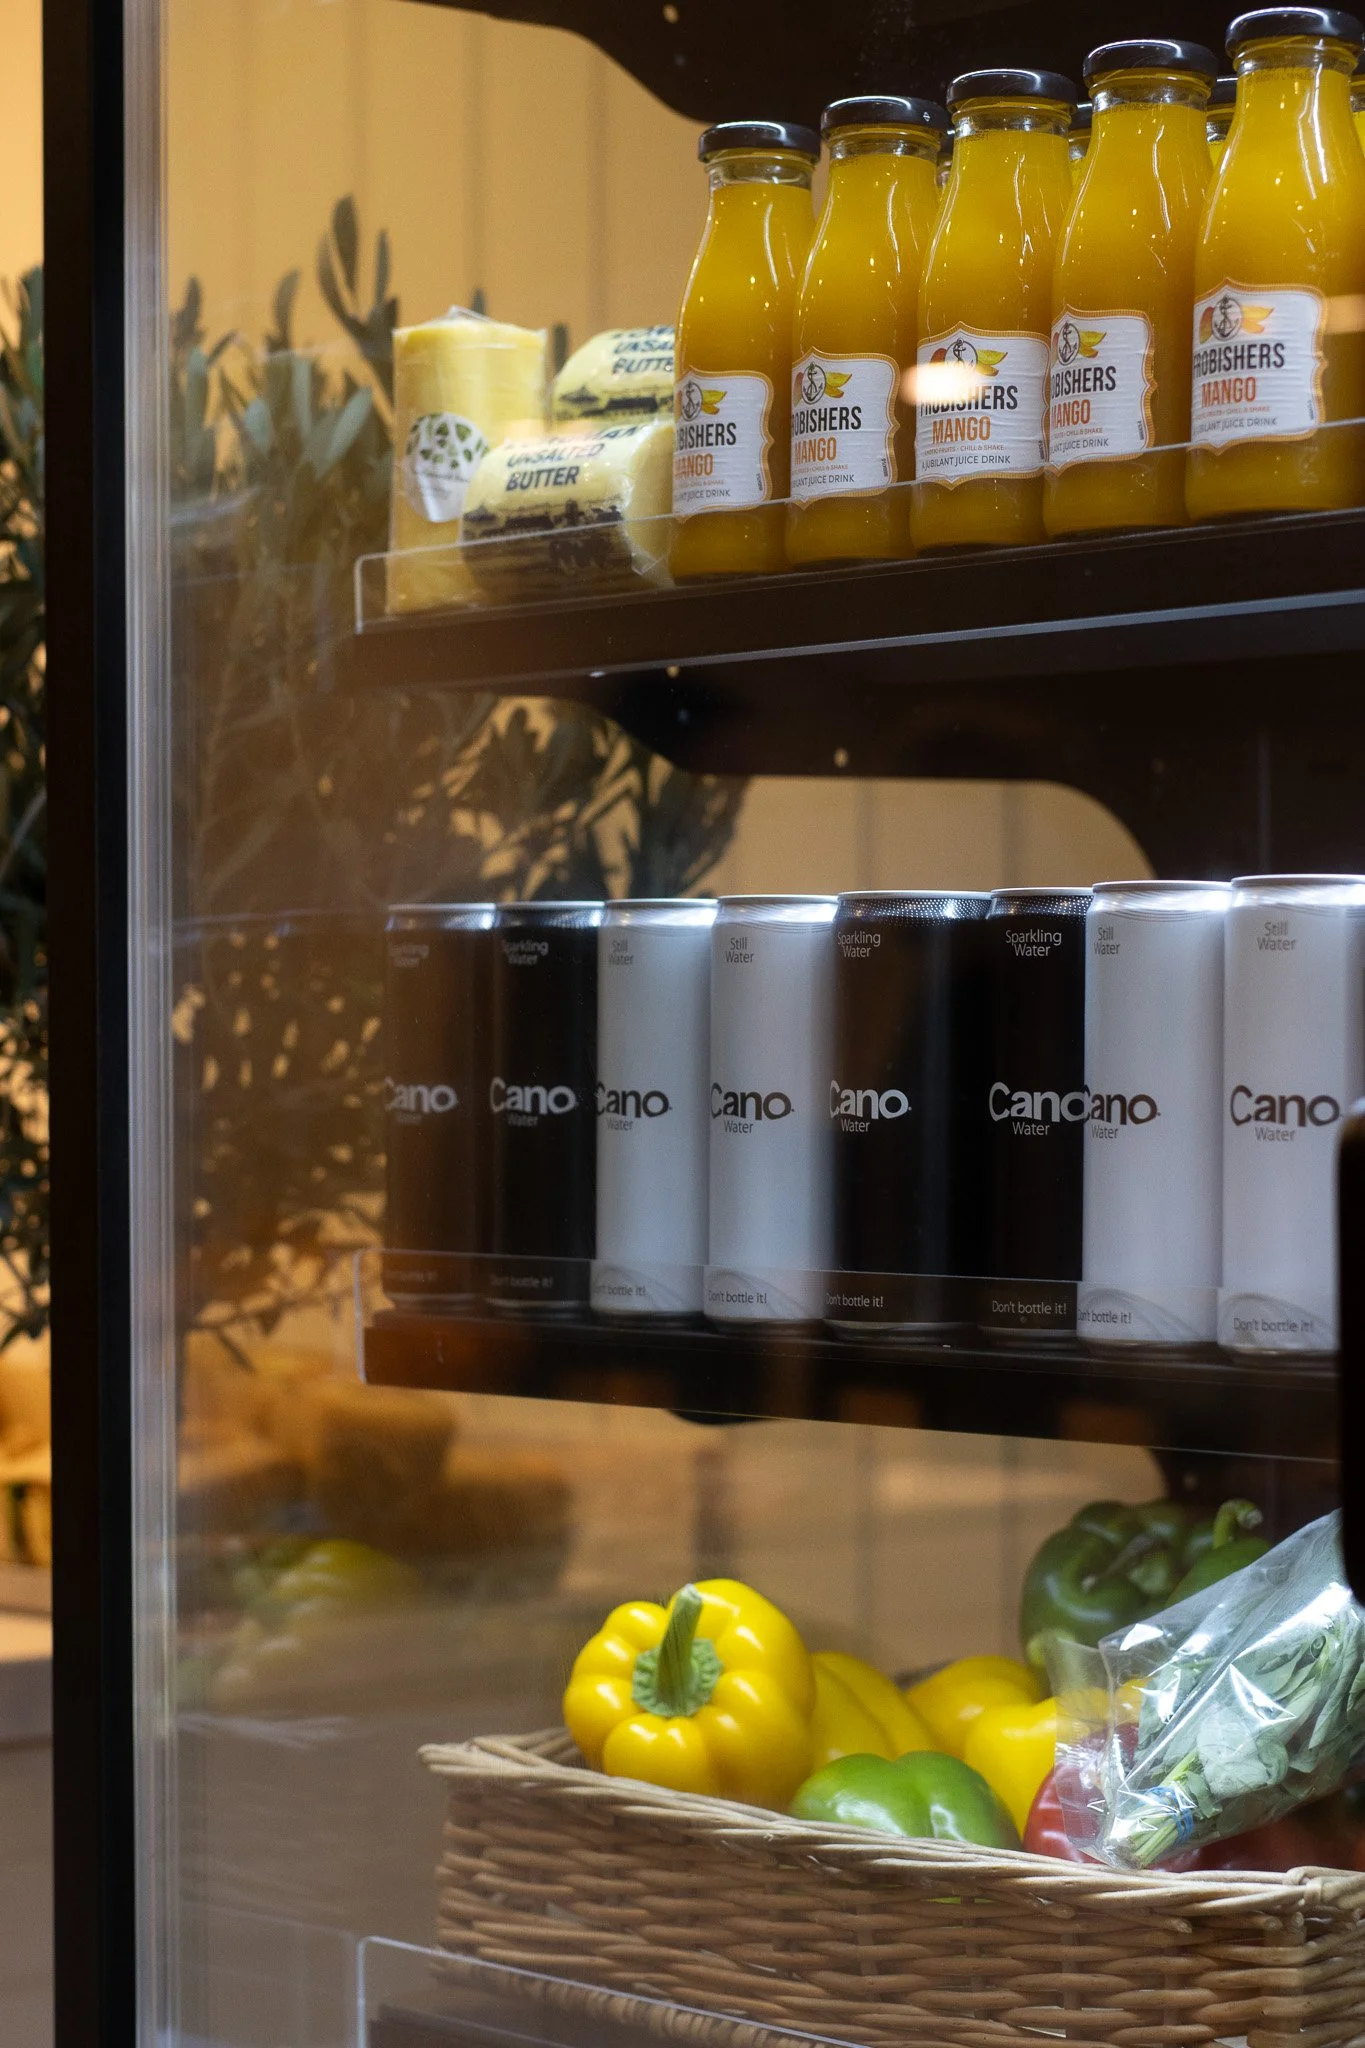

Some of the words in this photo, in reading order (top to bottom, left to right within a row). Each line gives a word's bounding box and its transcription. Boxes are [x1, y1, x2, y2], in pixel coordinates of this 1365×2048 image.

[1193, 343, 1286, 378] FROBISHERS
[1201, 376, 1257, 408] MANGO
[931, 415, 992, 445] MANGO
[1221, 418, 1244, 431] JUICE
[1246, 417, 1278, 428] DRINK
[794, 436, 837, 465] MANGO
[1062, 440, 1081, 453] JUICE
[1082, 438, 1109, 448] DRINK
[925, 457, 954, 471] JUBILANT
[954, 456, 979, 468] JUICE
[981, 455, 1011, 464] DRINK
[506, 466, 580, 492] BUTTER
[808, 475, 827, 487] JUICE
[828, 474, 855, 483] DRINK
[705, 489, 731, 499] DRINK
[1098, 926, 1115, 941] Still
[1264, 920, 1290, 937] Still
[730, 937, 748, 951] Still
[837, 931, 882, 948] Sparkling
[1005, 929, 1063, 947] Sparkling
[1257, 937, 1297, 952] Water
[611, 939, 629, 953] Still
[843, 945, 872, 958] Water
[1014, 944, 1051, 957] Water
[1094, 942, 1121, 956] Water
[609, 954, 634, 966] Water
[725, 951, 755, 964] Water
[490, 1076, 577, 1115] Cano
[711, 1082, 792, 1121] Cano
[829, 1079, 909, 1120] Cano
[989, 1081, 1087, 1123] Cano
[1230, 1084, 1341, 1127] Cano
[606, 1118, 634, 1131] Water
[723, 1119, 755, 1134] Water
[840, 1118, 871, 1133] Water
[1012, 1121, 1050, 1136] Water
[1091, 1125, 1119, 1139] Water
[1255, 1126, 1296, 1142] Water
[608, 1285, 633, 1296] bottle
[725, 1291, 754, 1304] bottle
[756, 1292, 768, 1305] it!
[842, 1293, 871, 1308] bottle
[872, 1295, 884, 1308] it!
[992, 1300, 1016, 1314] Don't
[1017, 1301, 1052, 1315] bottle
[1054, 1302, 1067, 1316] it!
[1091, 1309, 1119, 1324] bottle
[1120, 1311, 1133, 1325] it!
[1233, 1317, 1259, 1332] Don't
[1260, 1318, 1299, 1333] bottle
